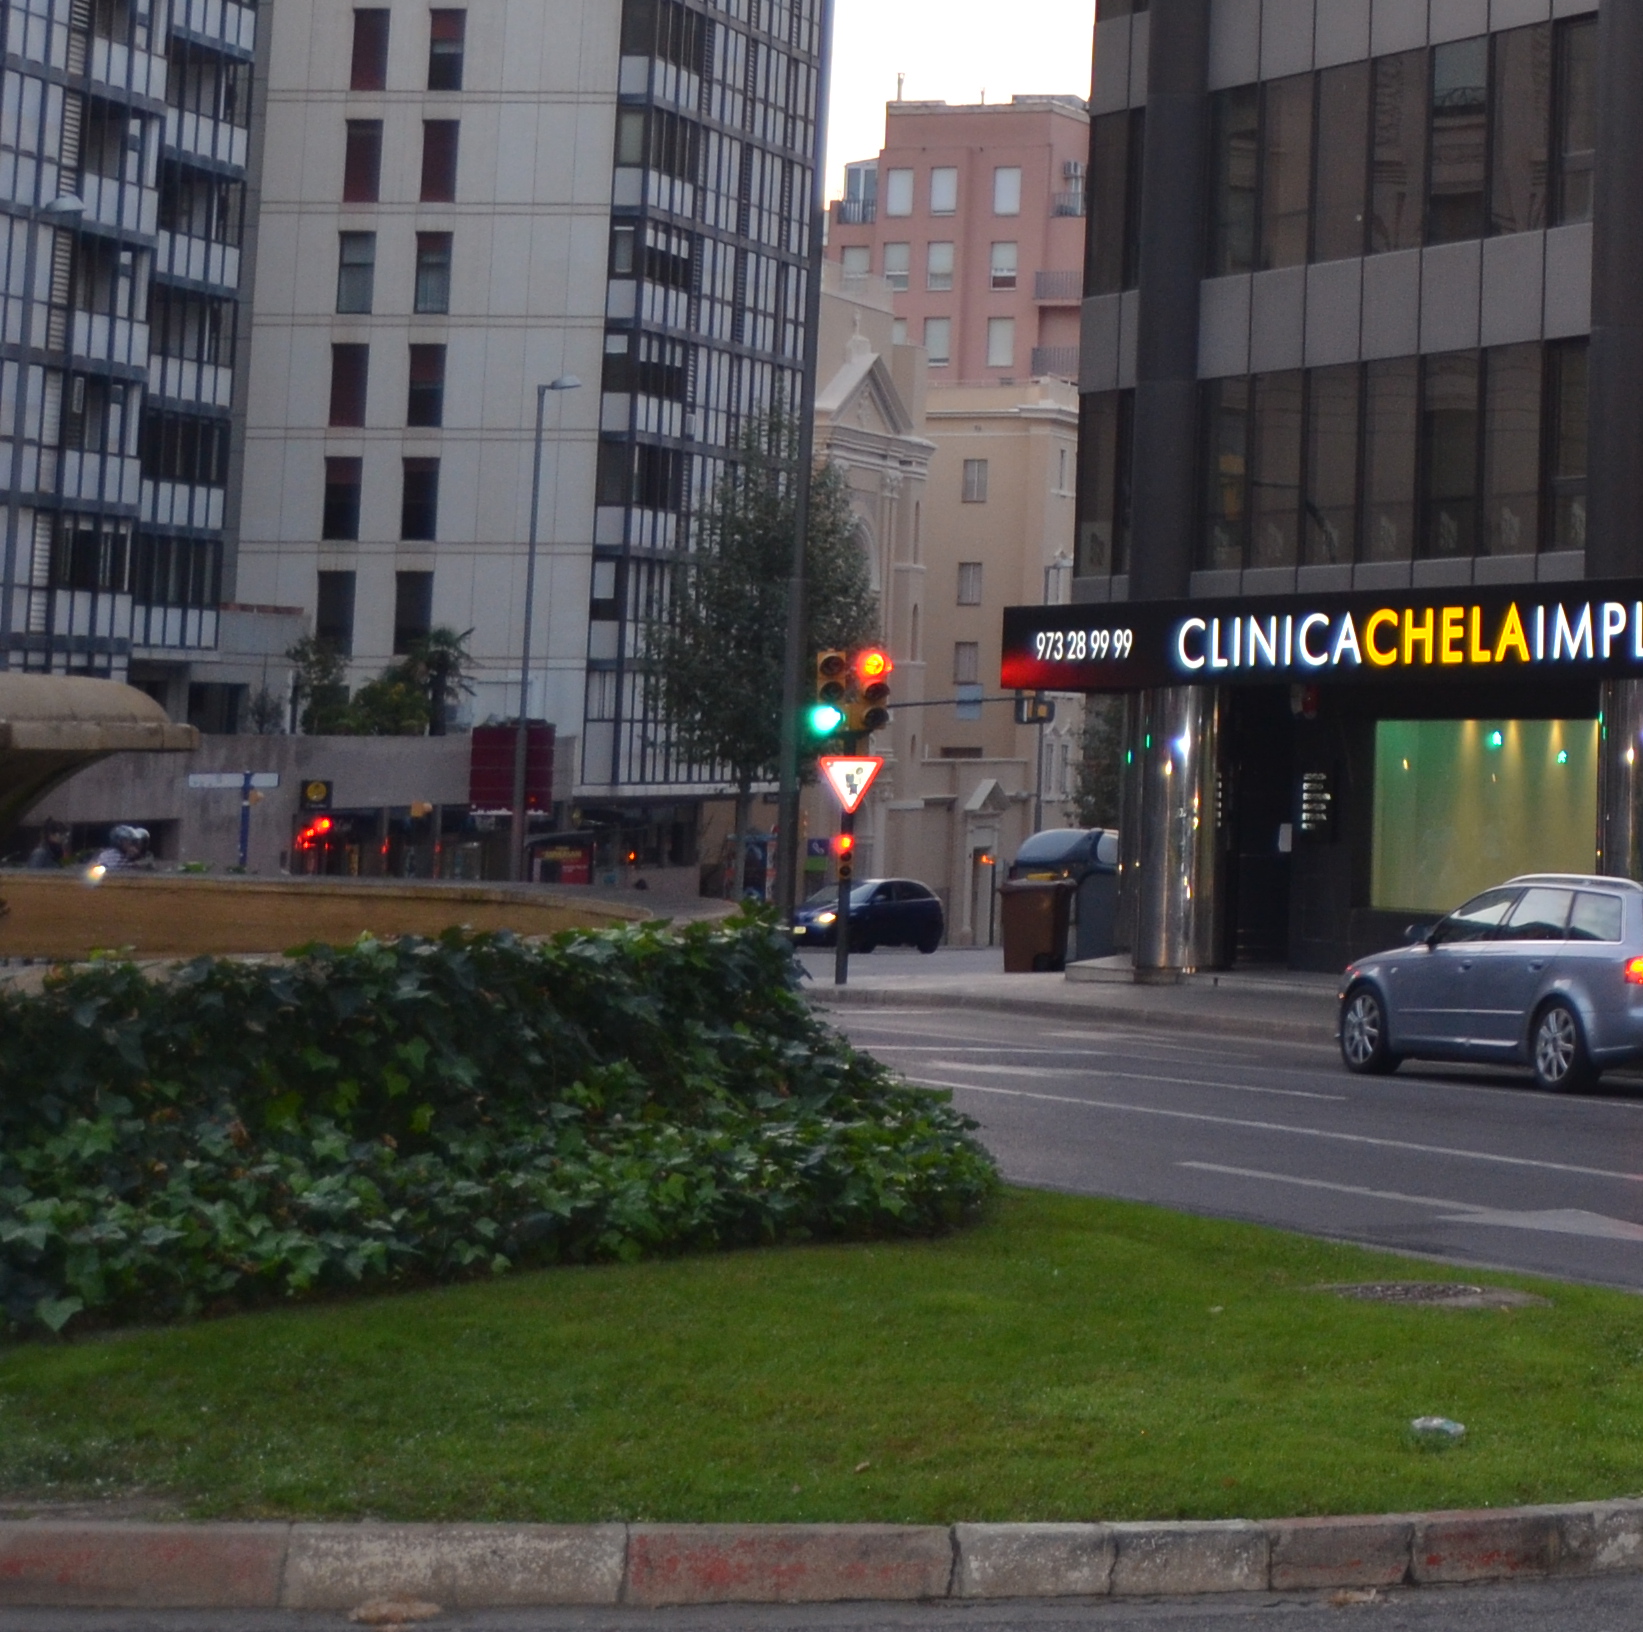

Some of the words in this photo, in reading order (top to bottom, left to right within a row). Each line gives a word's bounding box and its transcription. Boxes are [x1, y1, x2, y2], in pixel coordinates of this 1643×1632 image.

[1036, 631, 1064, 661] 973
[1067, 630, 1087, 660] 28
[1089, 629, 1110, 659] 99
[1113, 628, 1134, 659] 99
